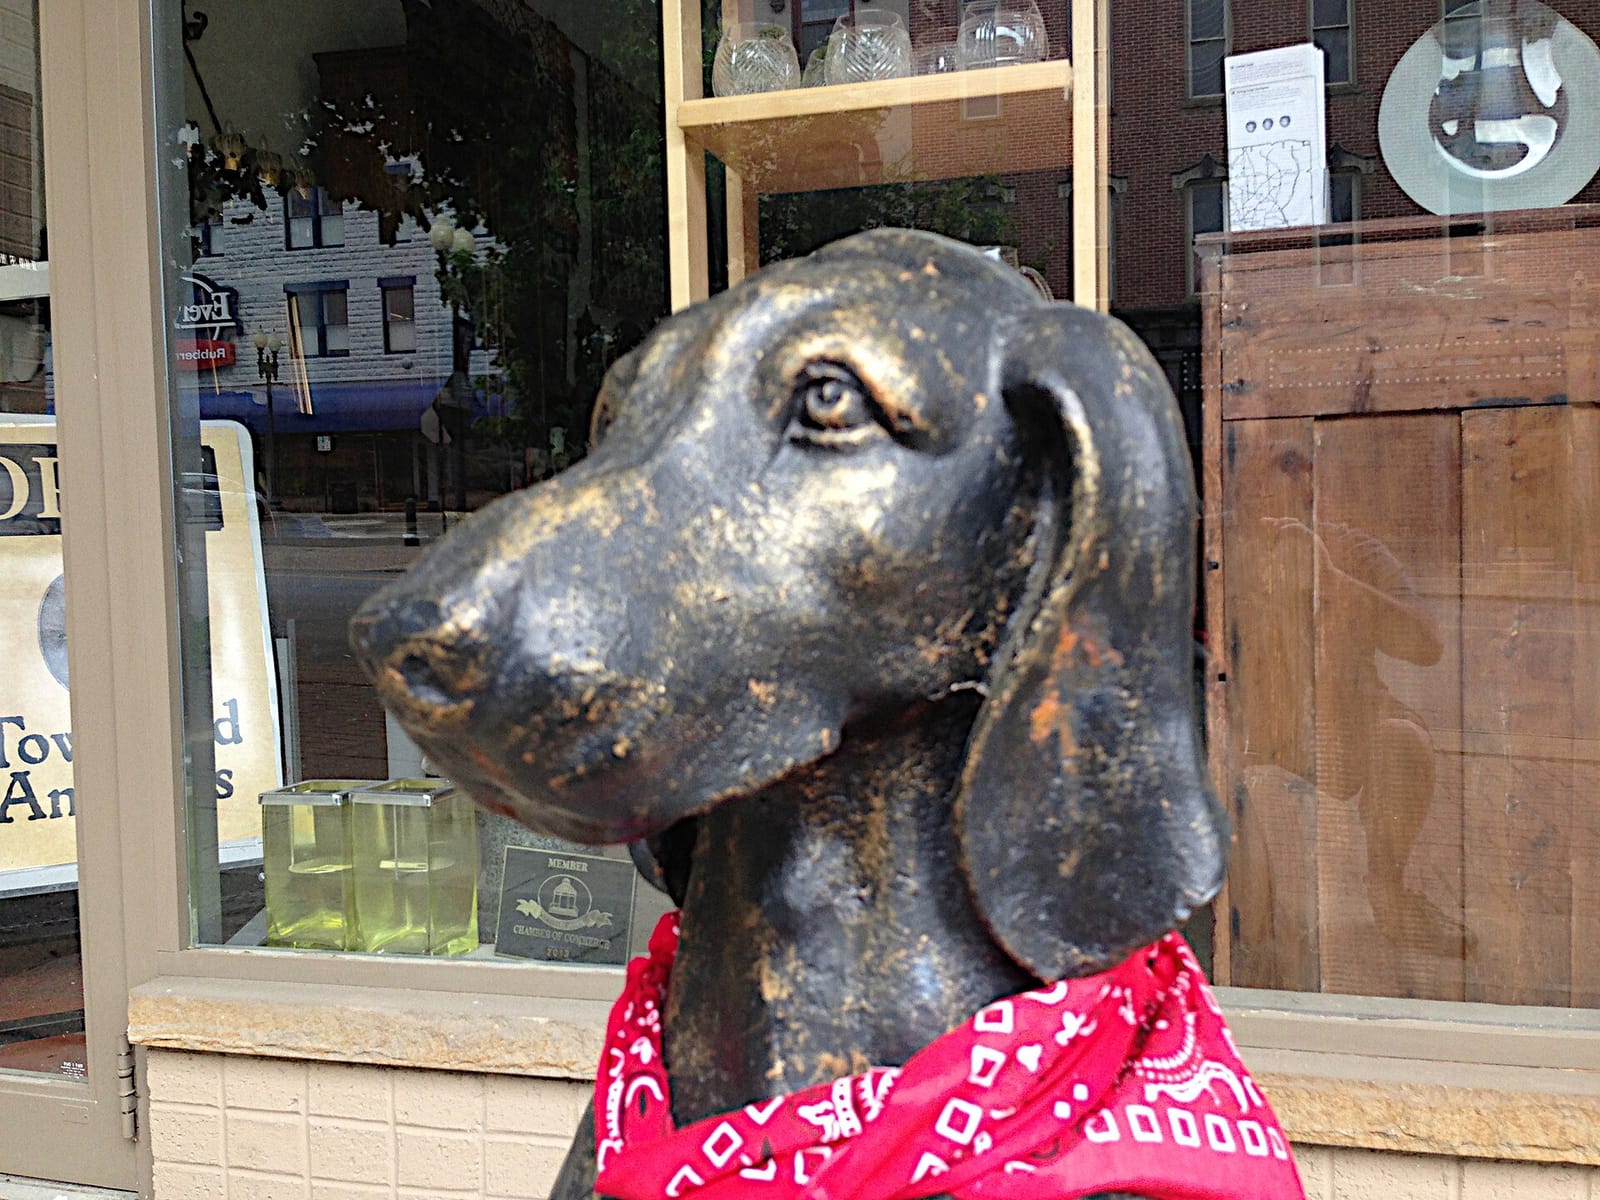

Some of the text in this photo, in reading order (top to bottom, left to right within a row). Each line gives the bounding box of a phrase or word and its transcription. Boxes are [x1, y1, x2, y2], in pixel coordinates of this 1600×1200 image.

[548, 858, 588, 872] MEMBER
[513, 925, 610, 950] CHAMBER OF COMMERCE
